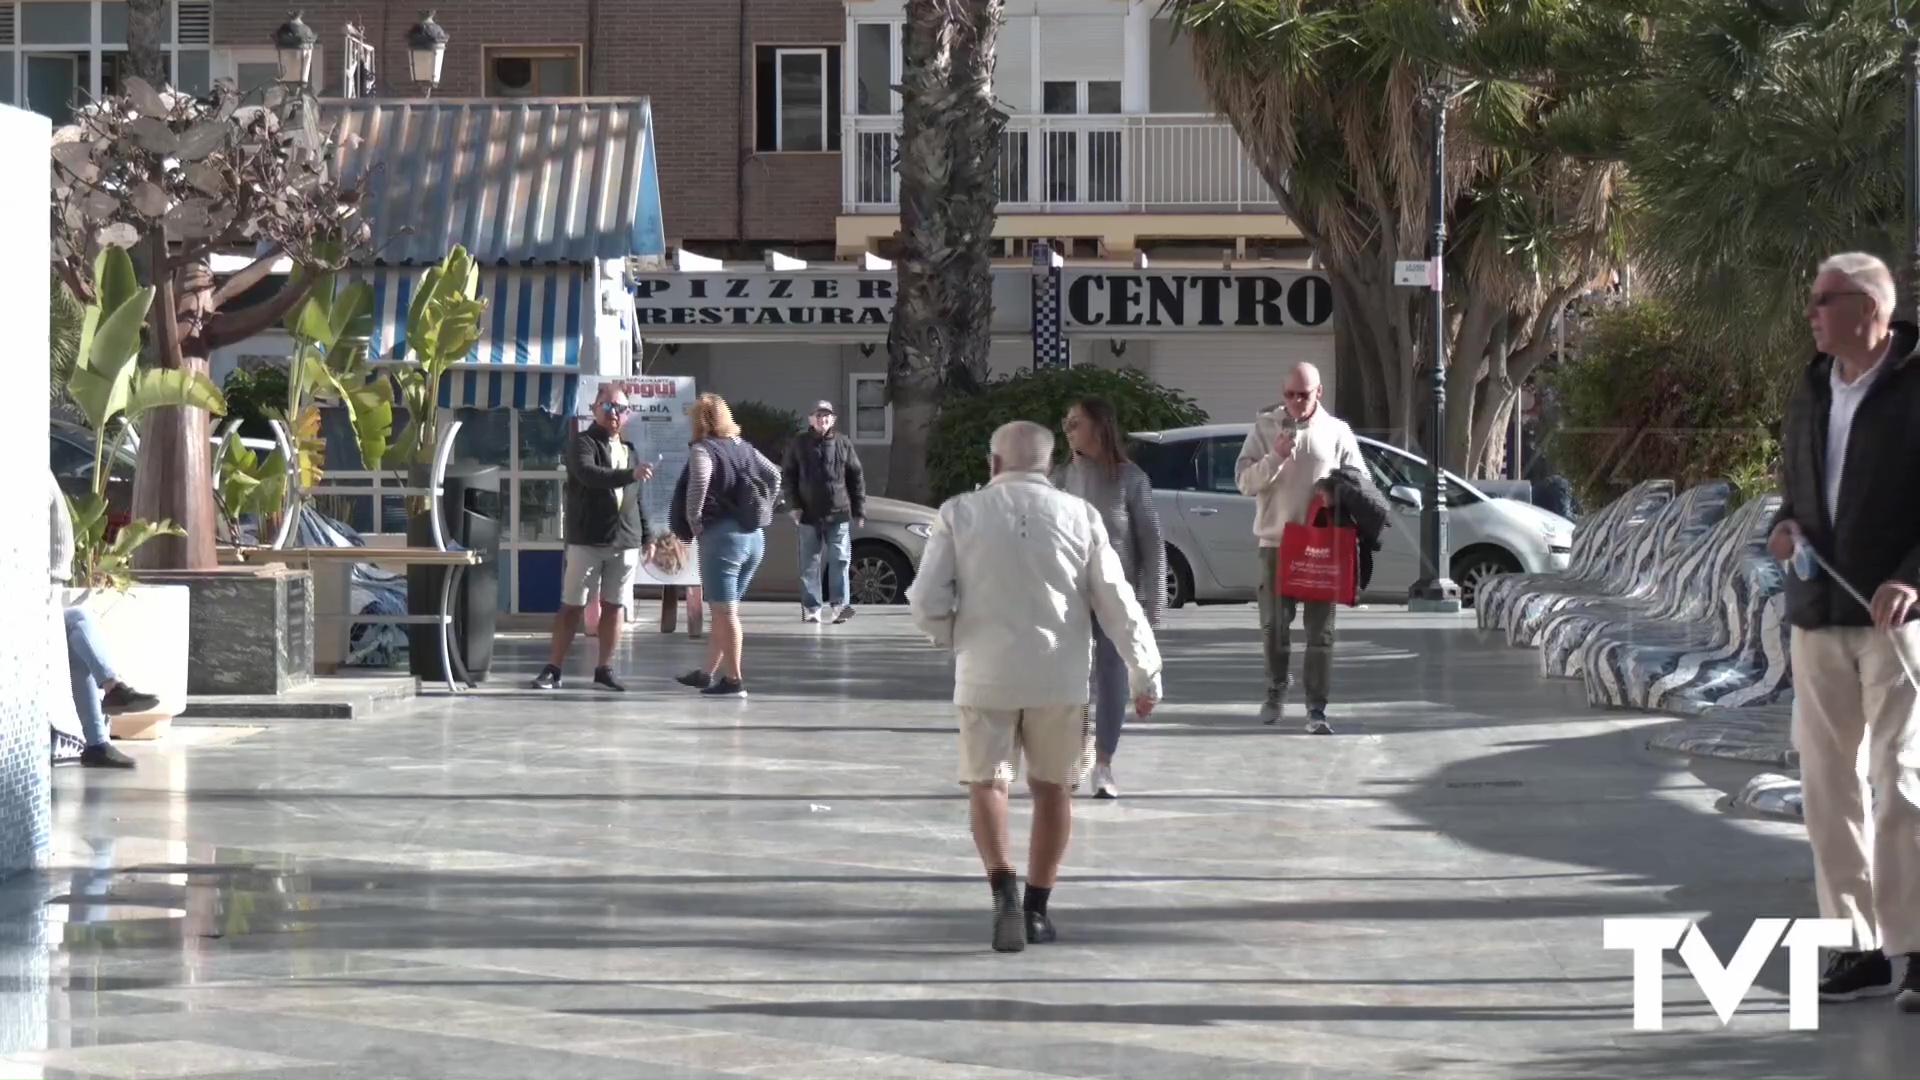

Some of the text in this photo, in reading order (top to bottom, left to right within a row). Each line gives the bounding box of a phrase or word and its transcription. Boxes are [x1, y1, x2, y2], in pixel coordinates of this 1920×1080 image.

[1067, 274, 1334, 327] CENTRO
[635, 307, 893, 325] RESTAURA
[649, 402, 670, 413] DÍA
